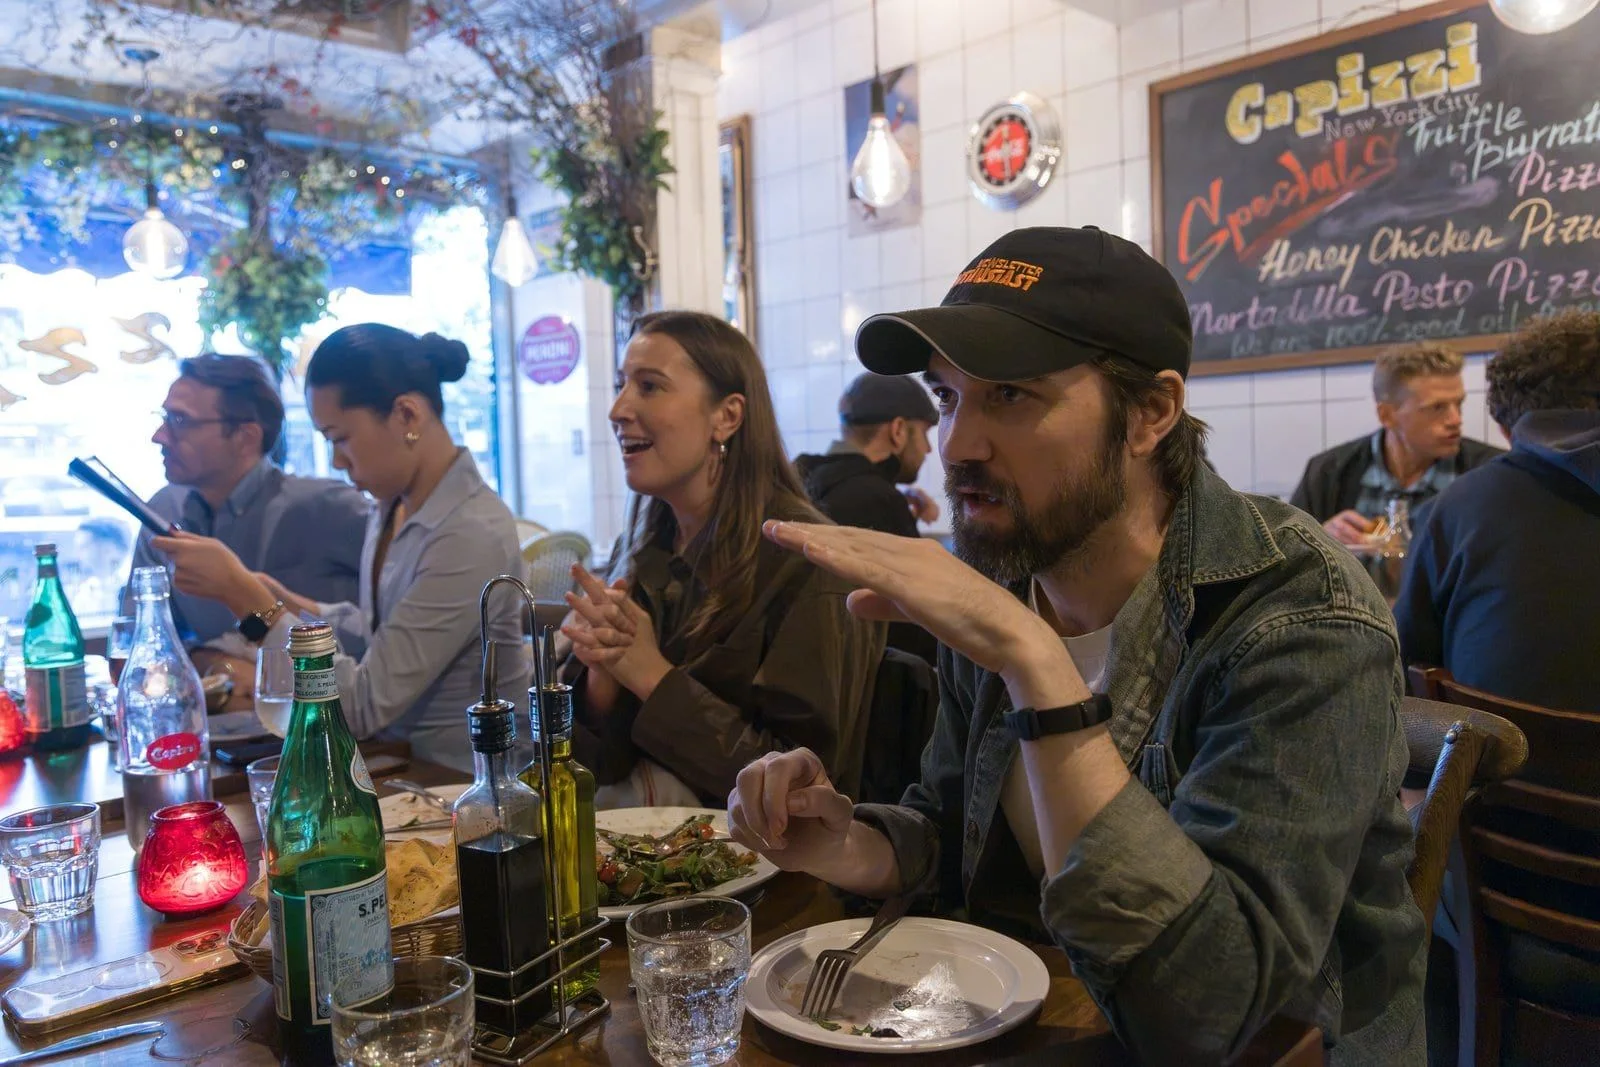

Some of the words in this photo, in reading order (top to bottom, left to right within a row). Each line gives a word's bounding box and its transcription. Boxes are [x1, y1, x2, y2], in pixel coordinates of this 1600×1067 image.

[1225, 21, 1481, 144] Capizzi
[1323, 114, 1376, 142] New
[1381, 101, 1434, 128] York
[1434, 92, 1481, 116] City
[1406, 102, 1527, 156] Truffle
[1508, 150, 1600, 197] Pizz
[1258, 238, 1361, 292] Honey
[1368, 220, 1505, 265] Chicken
[1372, 270, 1474, 313] Pesto
